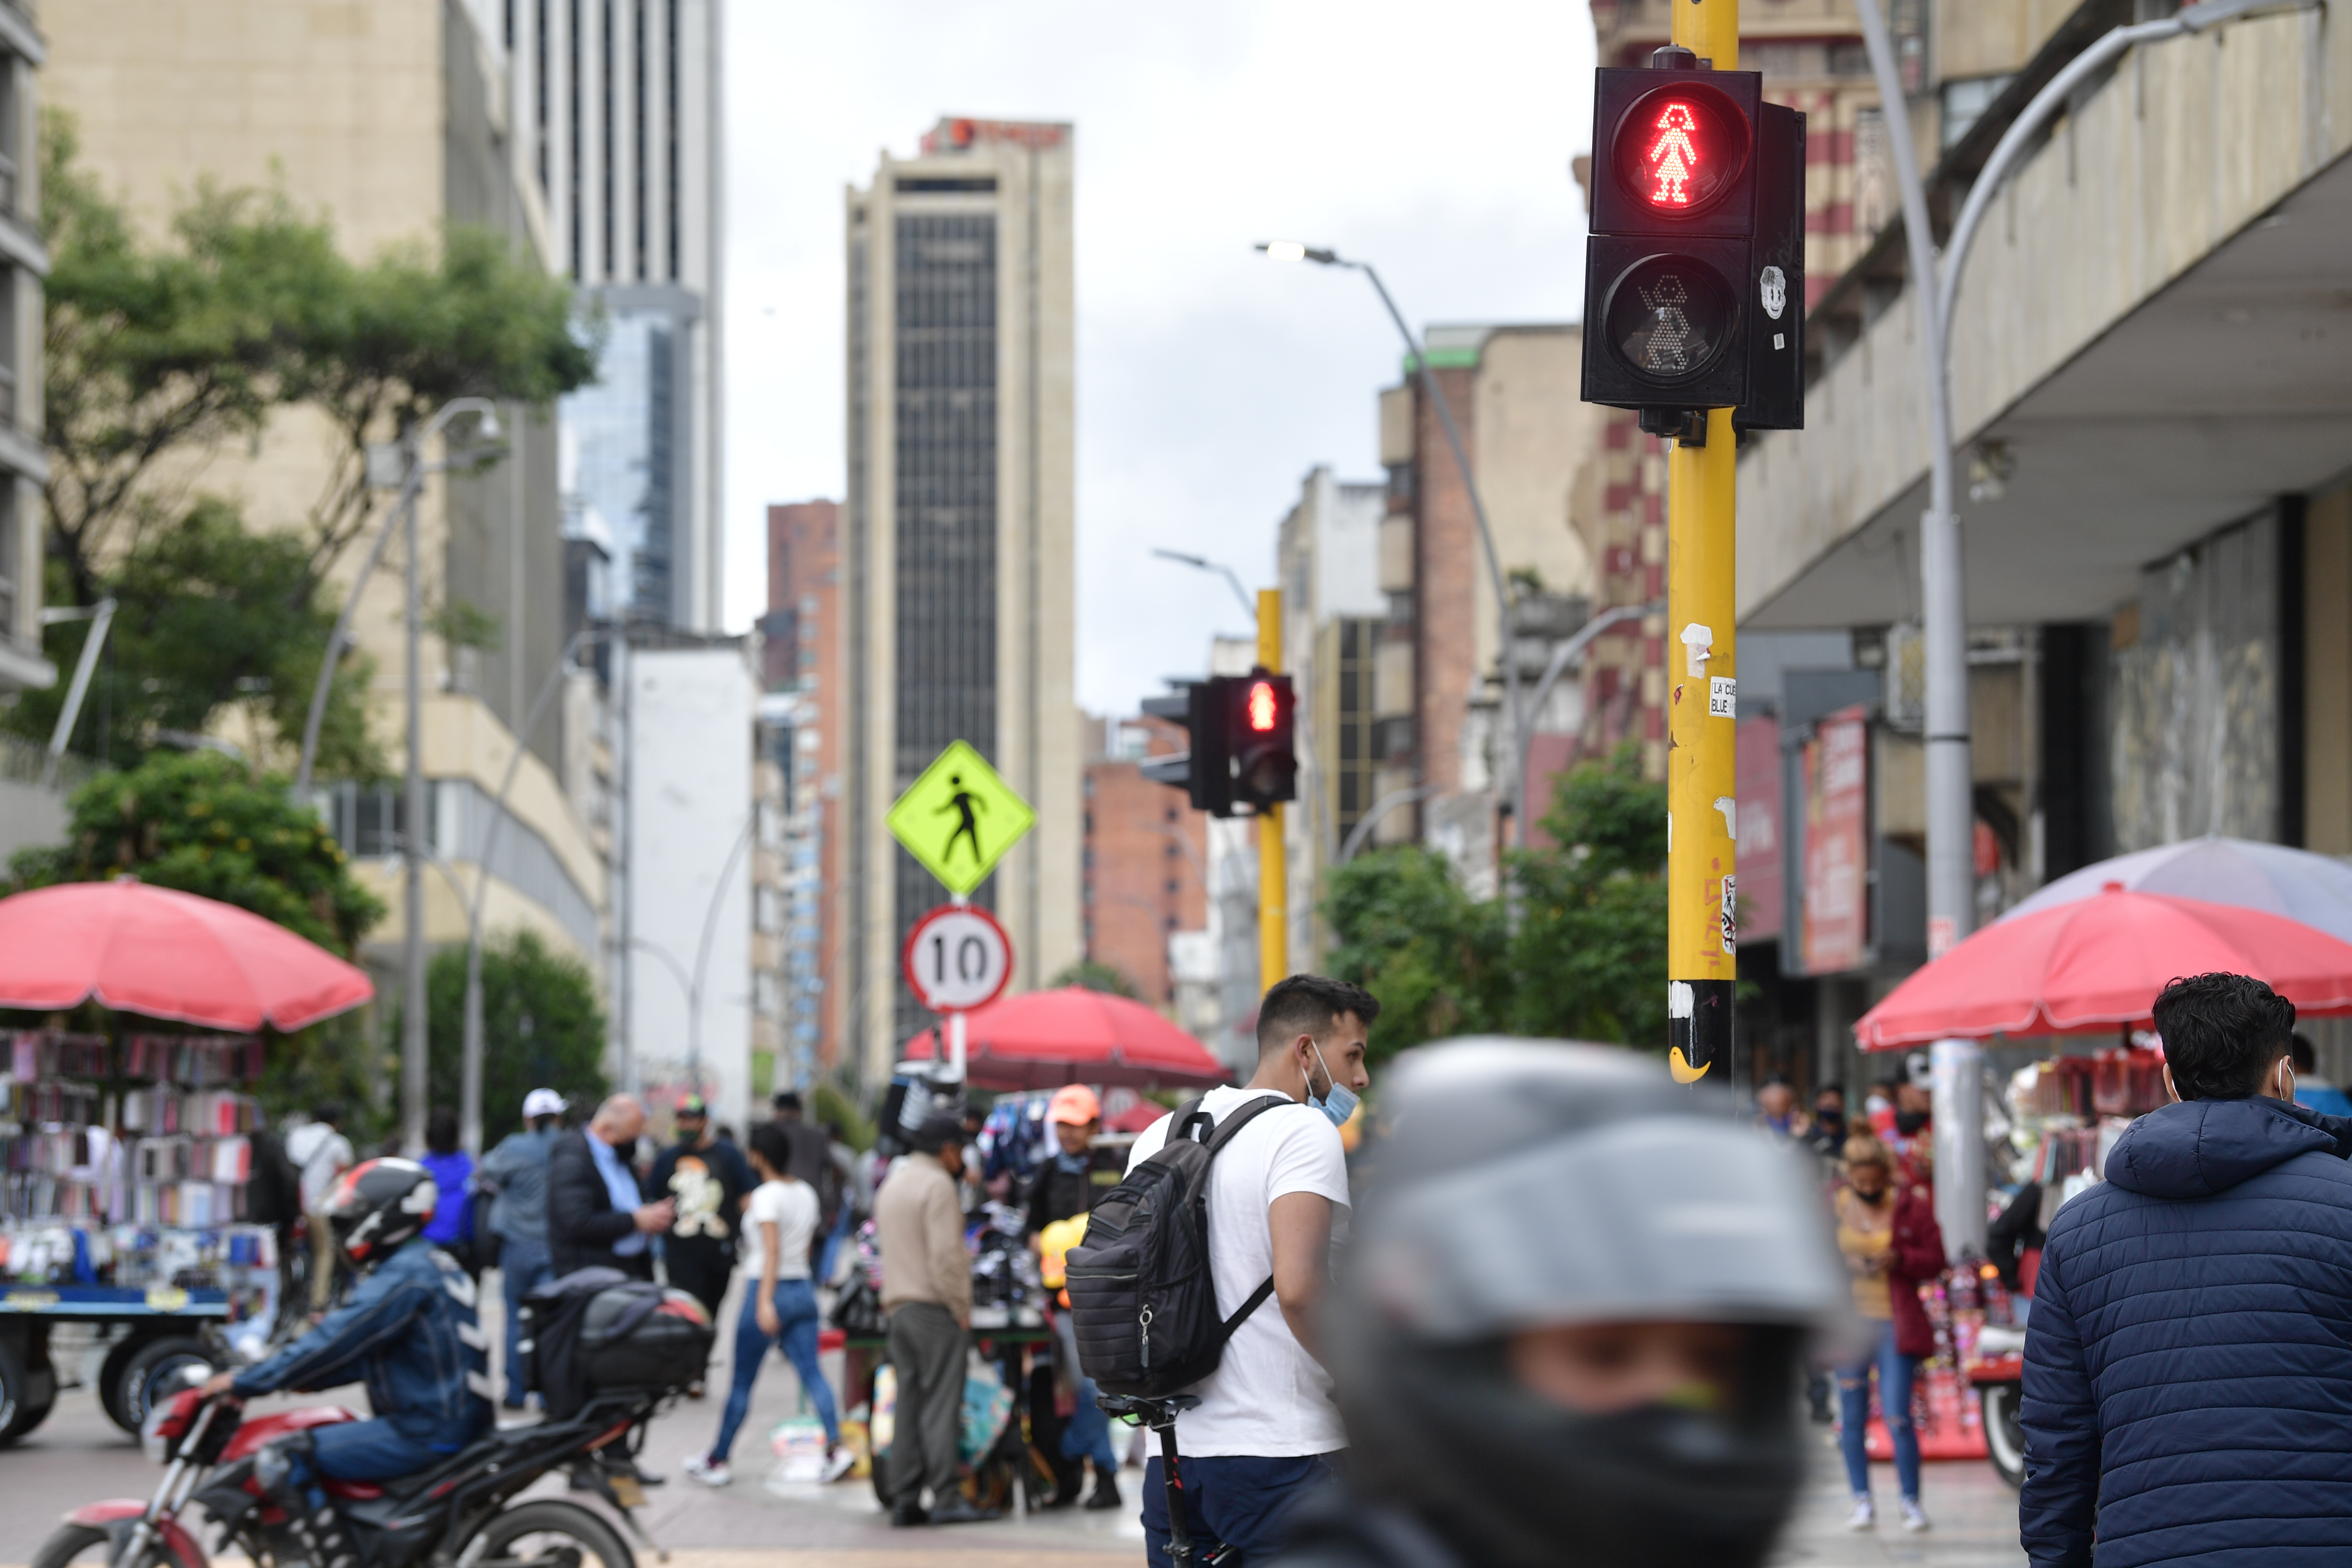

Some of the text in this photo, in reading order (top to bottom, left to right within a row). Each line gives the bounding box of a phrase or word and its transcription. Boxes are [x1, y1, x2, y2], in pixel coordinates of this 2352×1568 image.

[1714, 683, 1722, 694] LA
[1712, 699, 1727, 713] BLUE
[933, 934, 988, 984] 10
